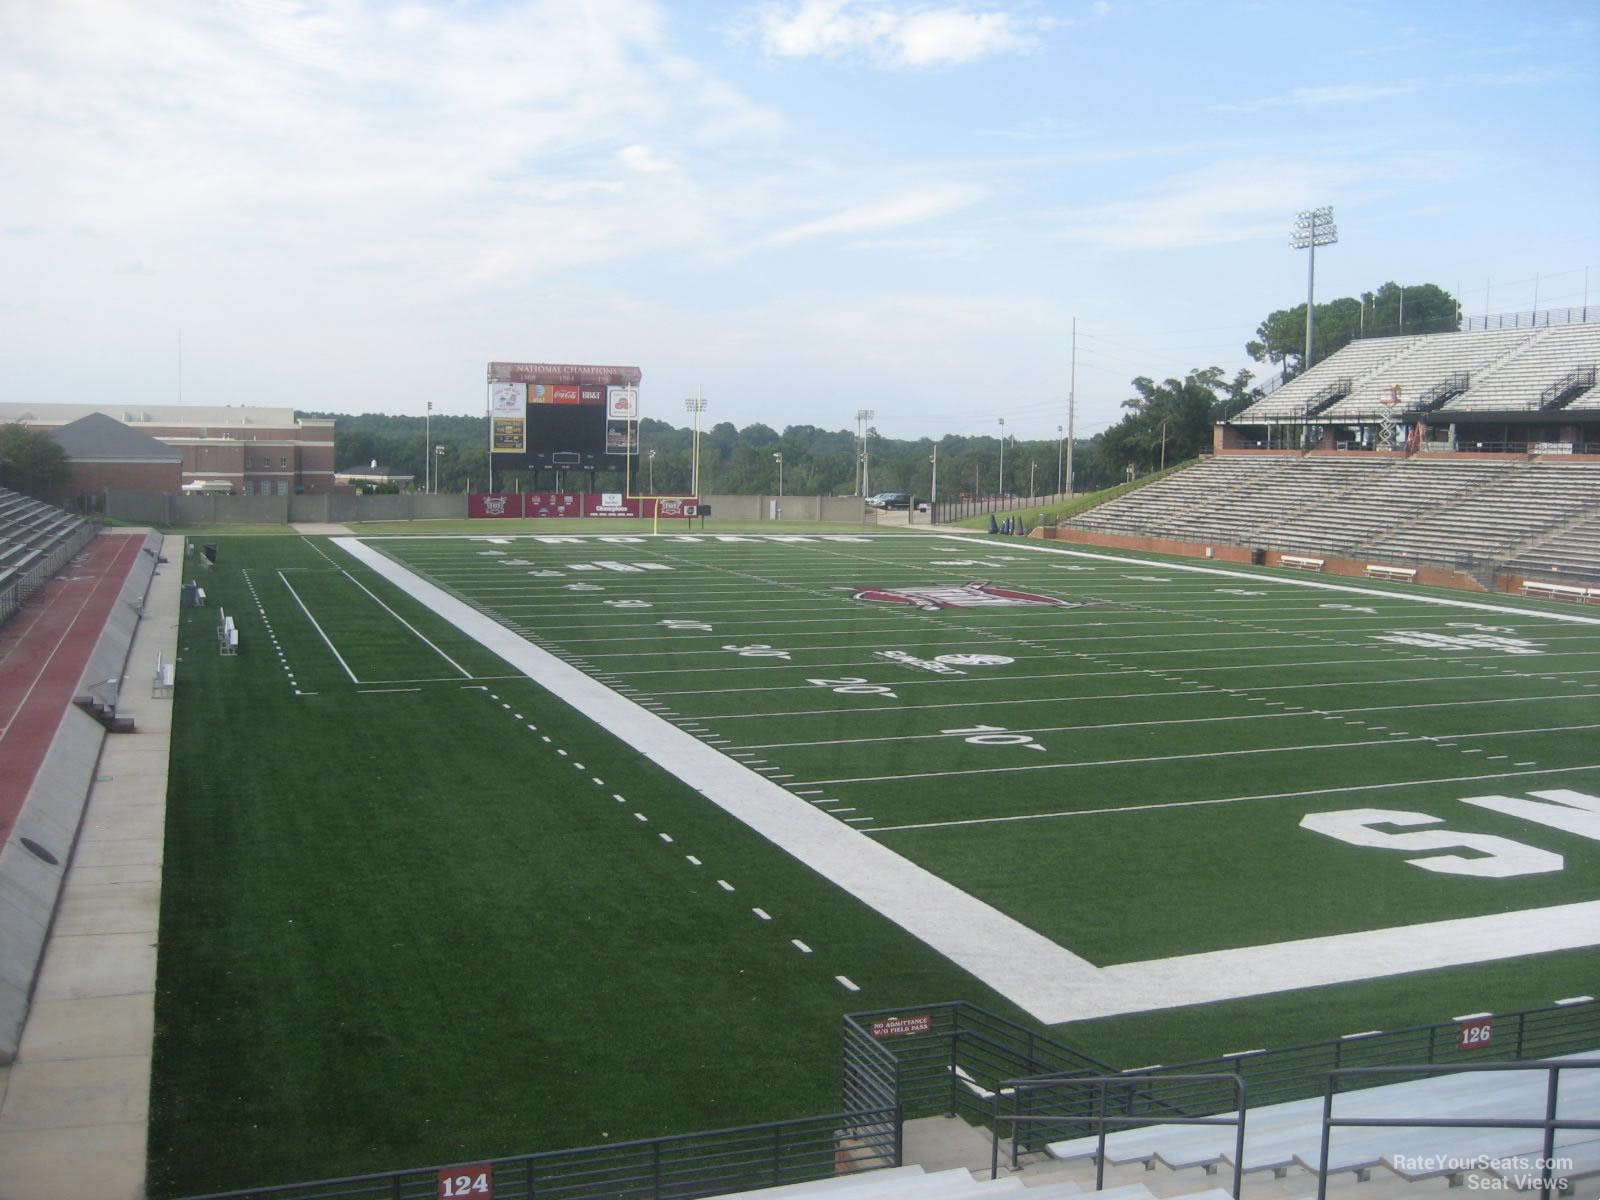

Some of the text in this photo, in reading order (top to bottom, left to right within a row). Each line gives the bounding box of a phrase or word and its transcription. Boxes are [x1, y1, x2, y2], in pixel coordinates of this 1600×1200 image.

[517, 365, 617, 375] NATIONAL CHAMPIONS
[582, 391, 601, 399] BB&T
[805, 677, 892, 694] 20
[940, 724, 1035, 745] 10
[885, 1018, 928, 1028] ADMITTANCE
[1462, 1025, 1491, 1044] 126
[442, 1173, 489, 1197] 124
